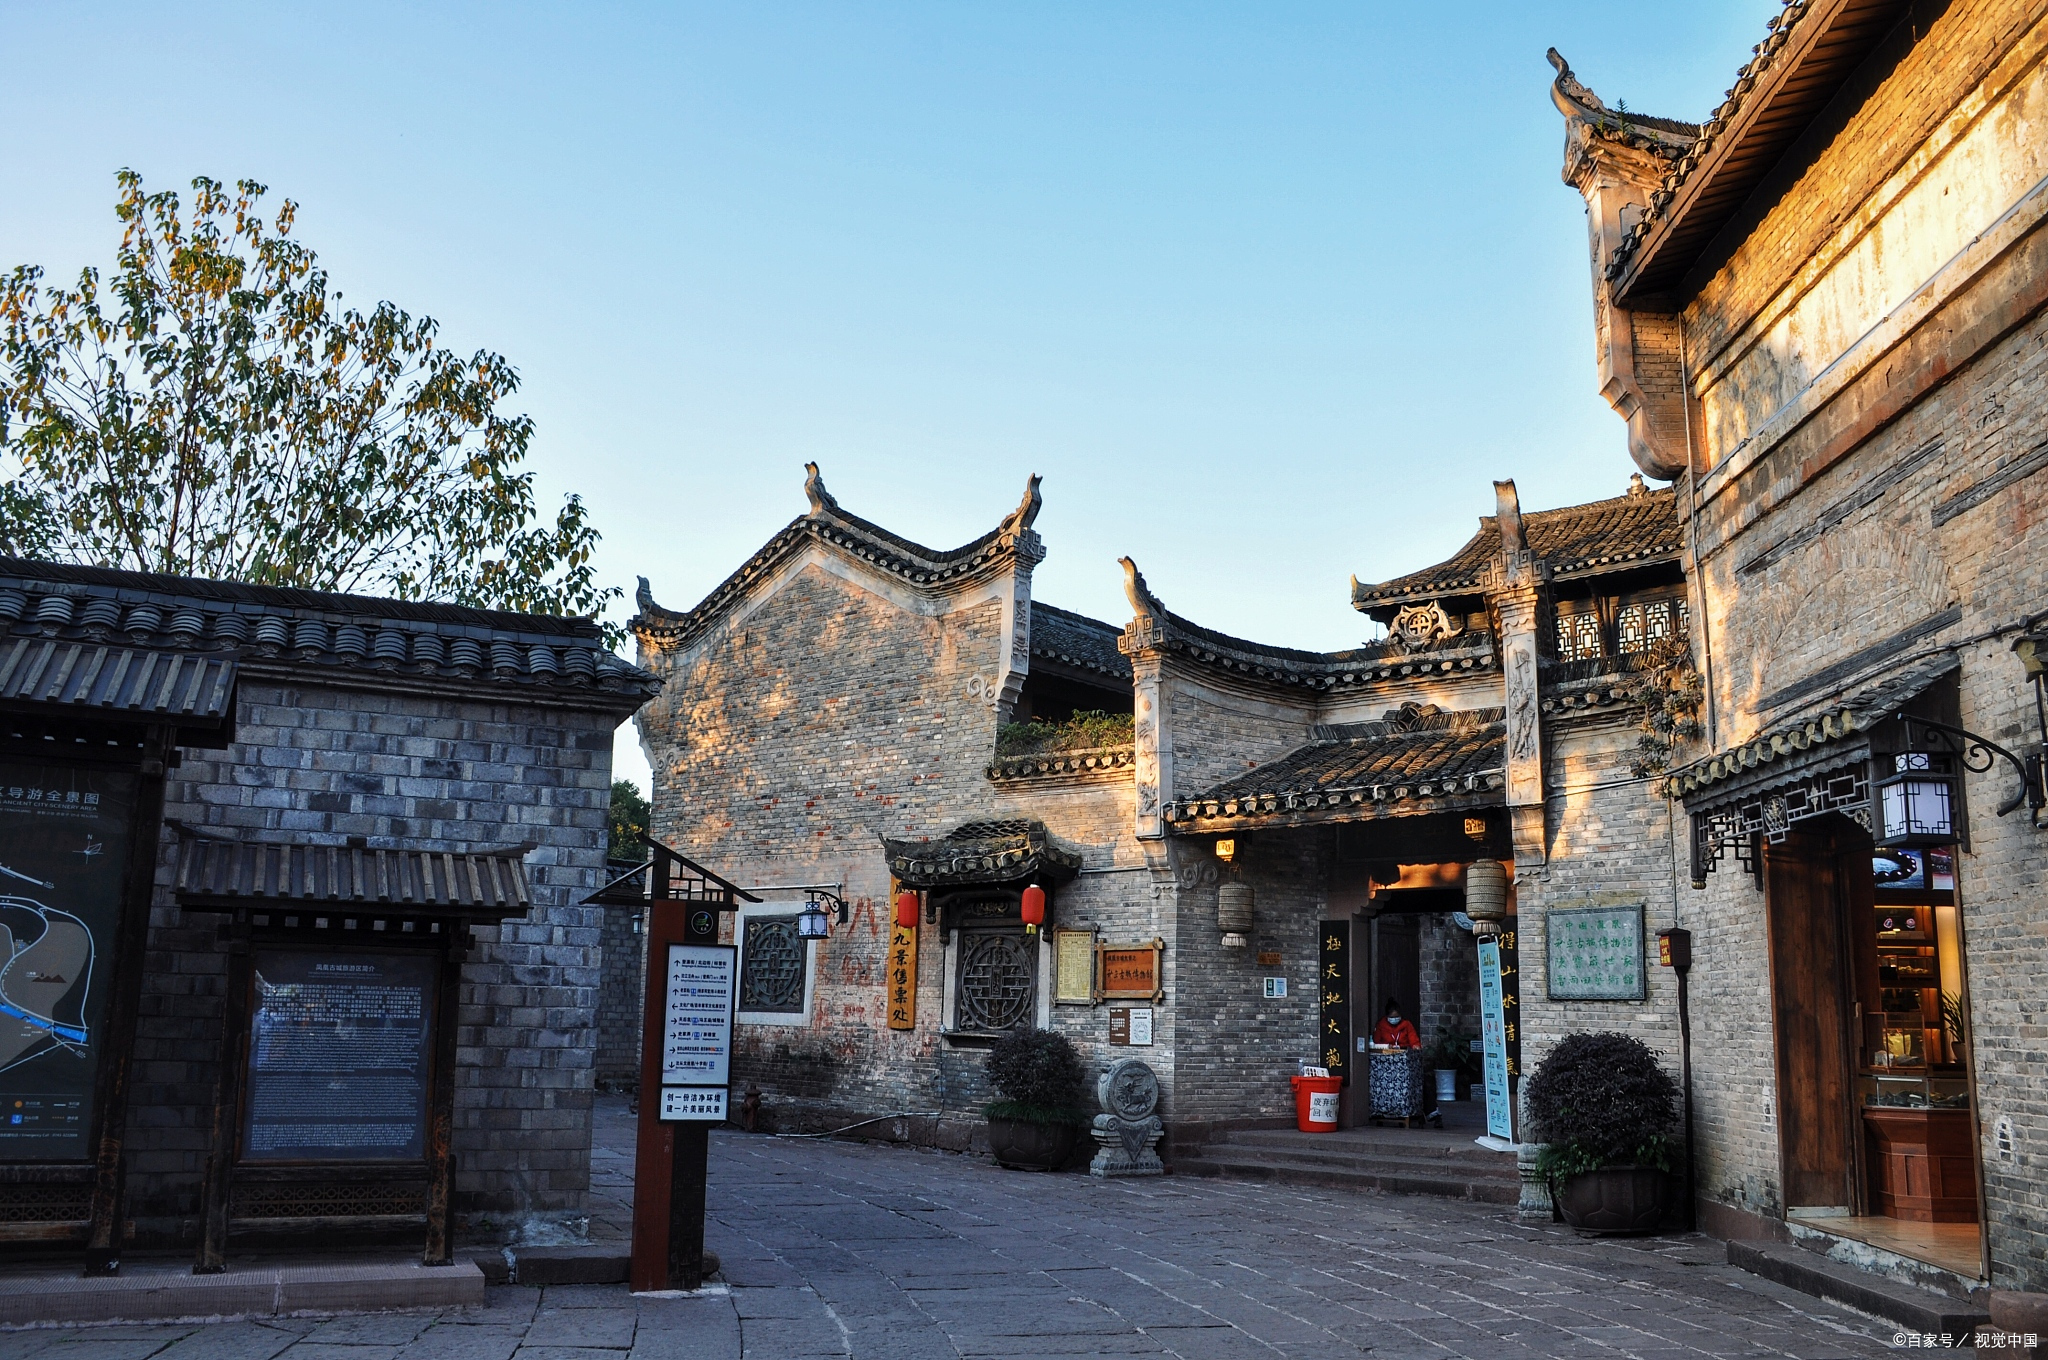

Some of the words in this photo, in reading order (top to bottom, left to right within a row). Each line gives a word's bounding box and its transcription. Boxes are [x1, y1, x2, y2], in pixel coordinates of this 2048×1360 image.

[1325, 935, 1343, 1068] 極天地大觀
[667, 1093, 721, 1102] 创一份洁净环境
[666, 1104, 720, 1113] 建一片美丽风景
[1313, 1109, 1337, 1118] 回收
